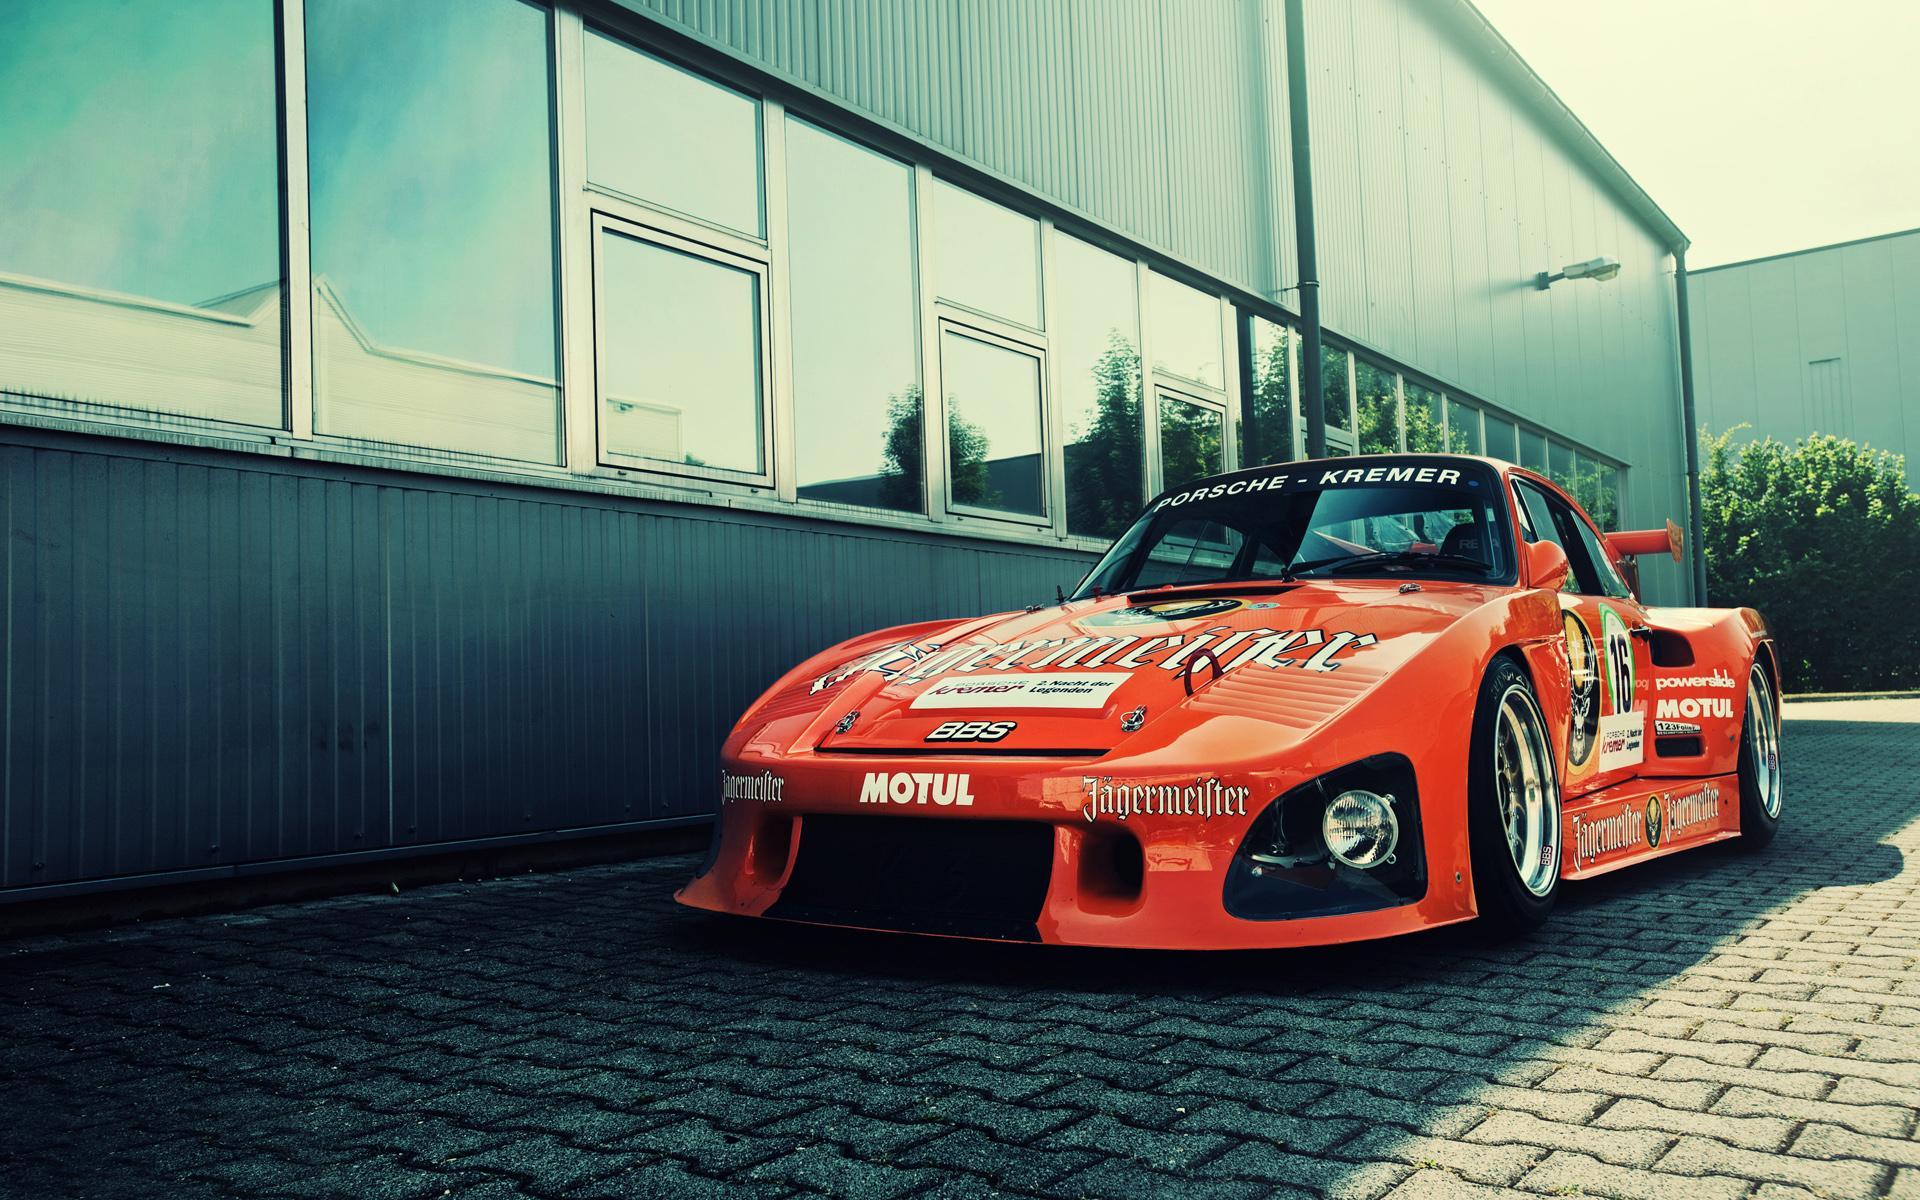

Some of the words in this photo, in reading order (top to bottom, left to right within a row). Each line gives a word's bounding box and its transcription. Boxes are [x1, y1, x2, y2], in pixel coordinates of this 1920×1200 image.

[1154, 475, 1288, 512] PORSCHE
[1319, 468, 1461, 485] KREMER
[1610, 633, 1632, 714] 16
[1656, 668, 1735, 690] powerslide
[1029, 686, 1093, 694] Legenden
[1656, 698, 1733, 718] MOTUL
[925, 721, 1017, 742] BBS
[860, 773, 974, 806] MOTUL
[1541, 846, 1552, 866] BBS
